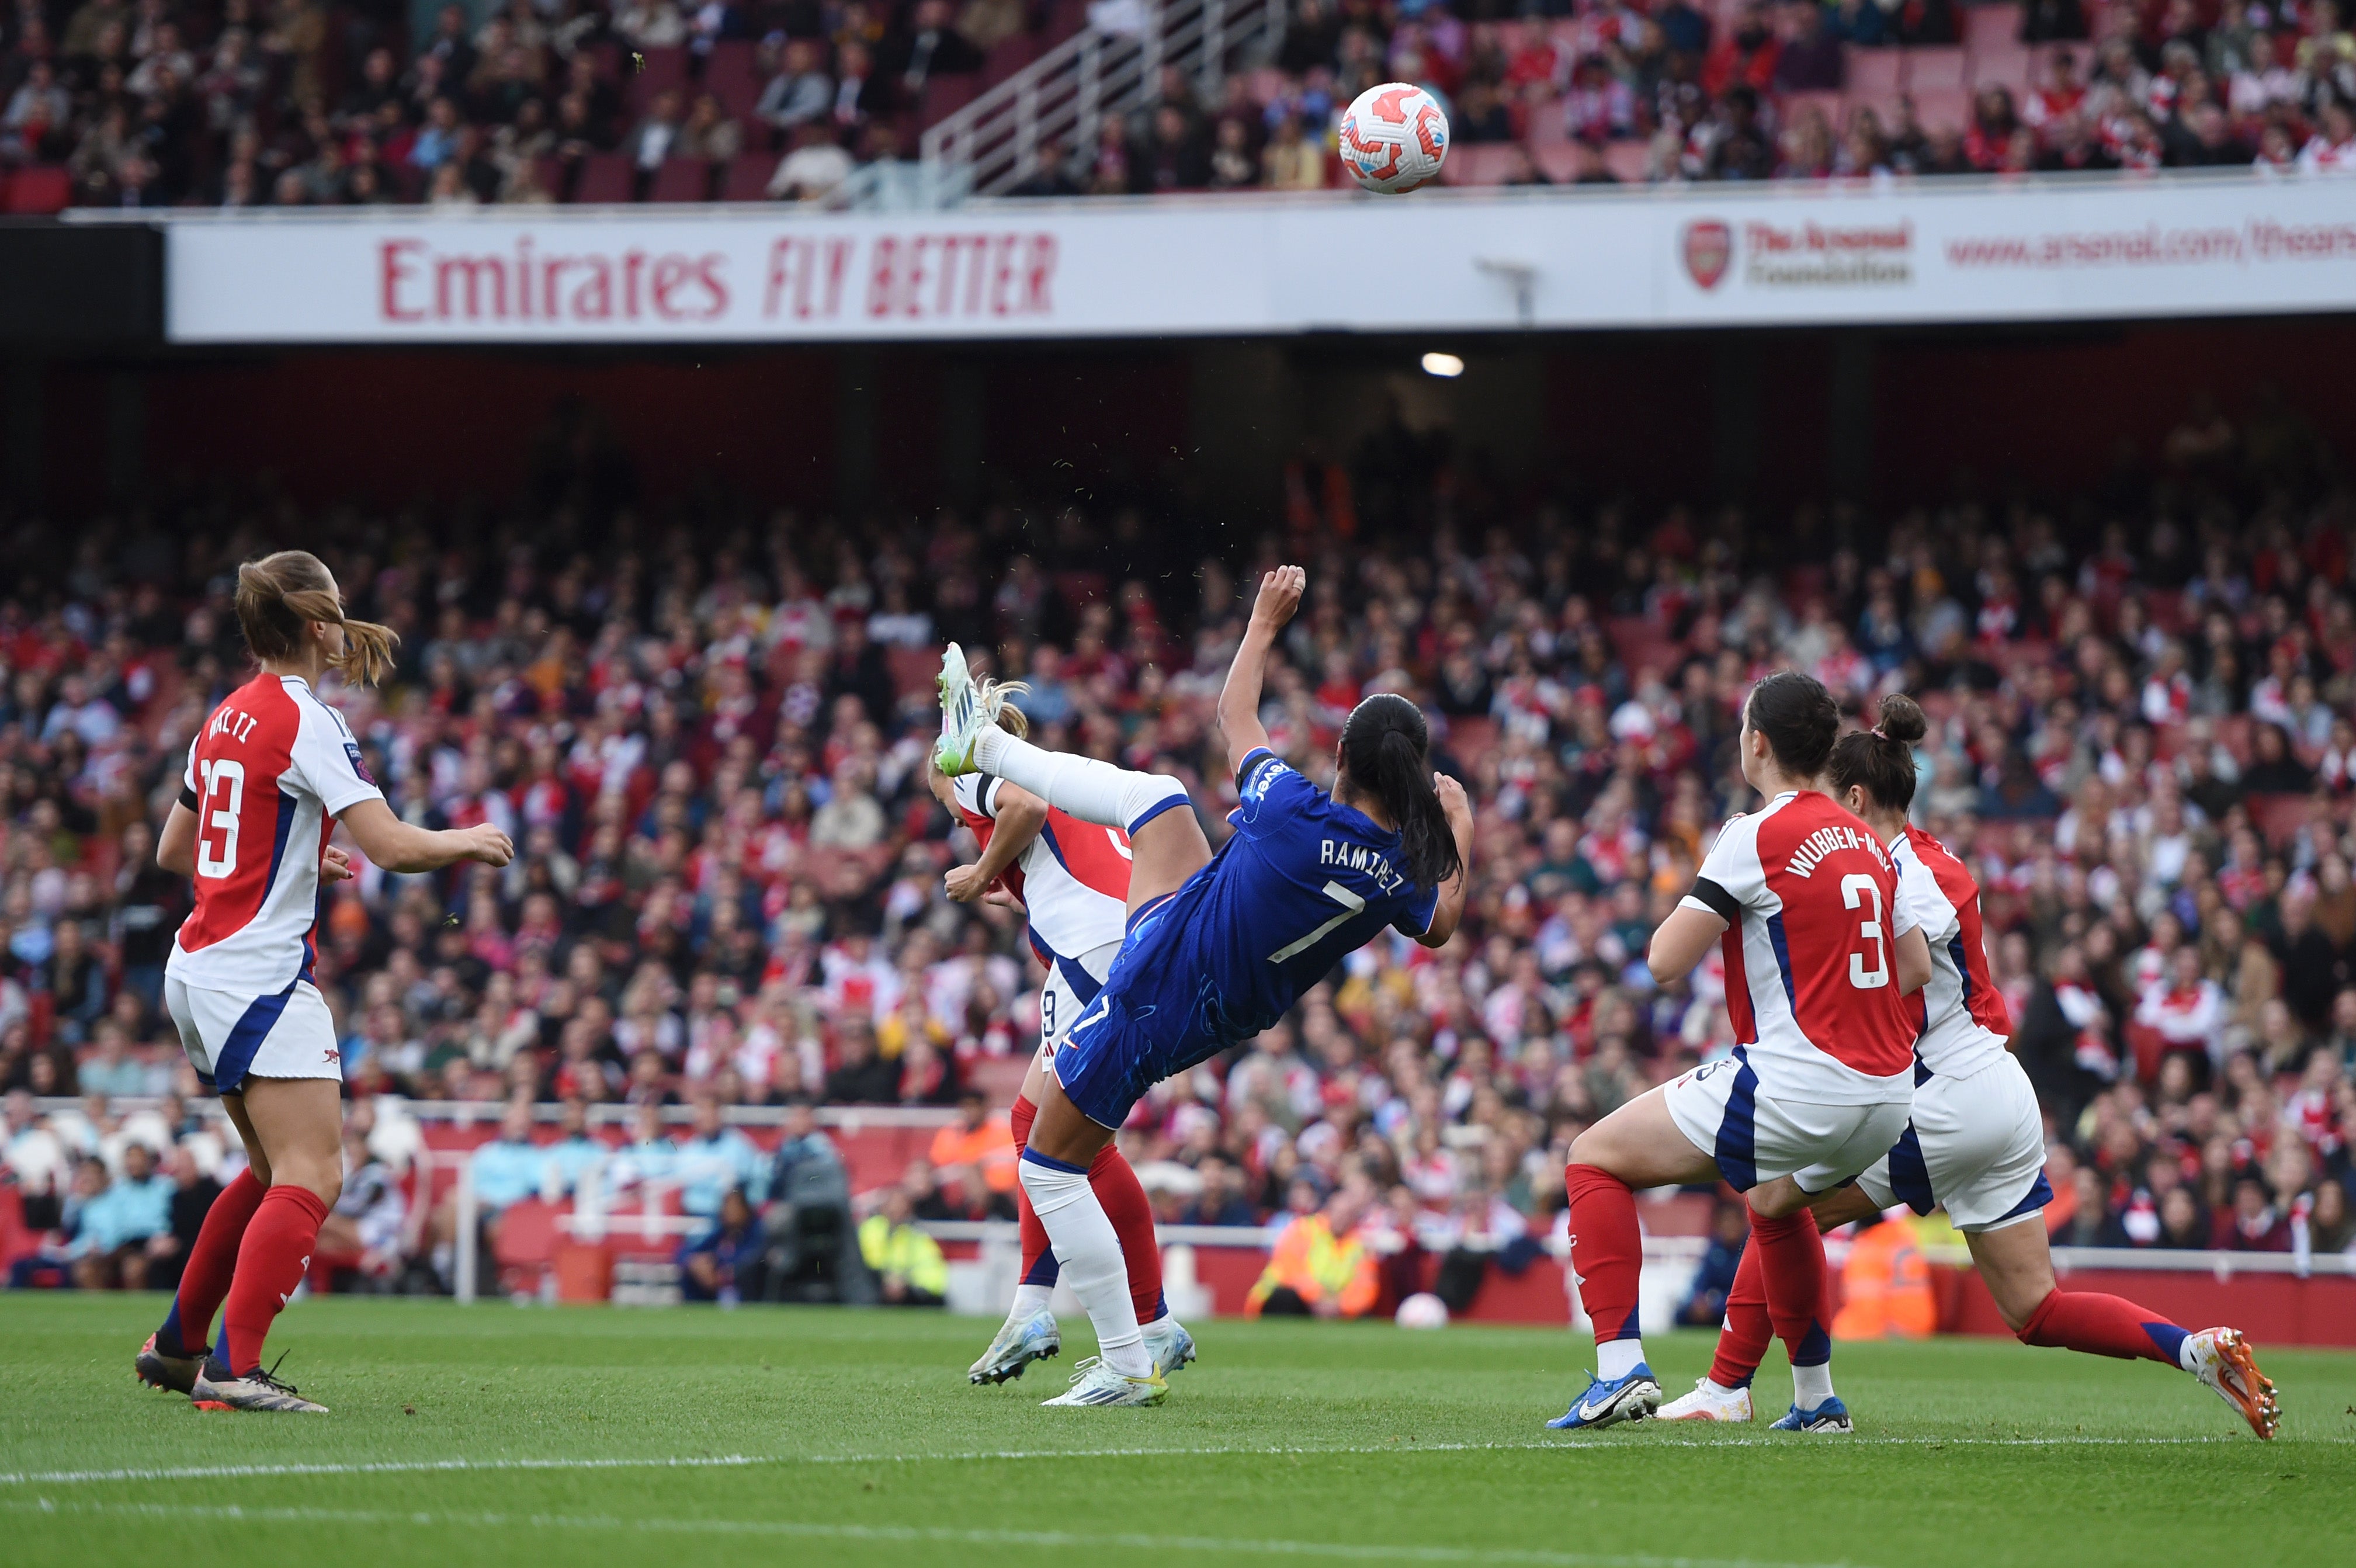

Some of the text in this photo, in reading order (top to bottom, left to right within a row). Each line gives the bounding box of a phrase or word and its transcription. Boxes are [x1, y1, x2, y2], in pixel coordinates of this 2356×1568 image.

[1806, 219, 1914, 252] Arsenal
[379, 235, 731, 321] Emirates
[761, 233, 1059, 320] FLY BETTER
[197, 759, 244, 878] 13
[1785, 826, 1892, 878] WUBBEN-MOY
[1320, 839, 1404, 897] RAMIREZ
[1266, 880, 1366, 964] 7
[1841, 873, 1889, 988] 3
[1043, 990, 1056, 1038] 9
[1074, 994, 1110, 1033] 7
